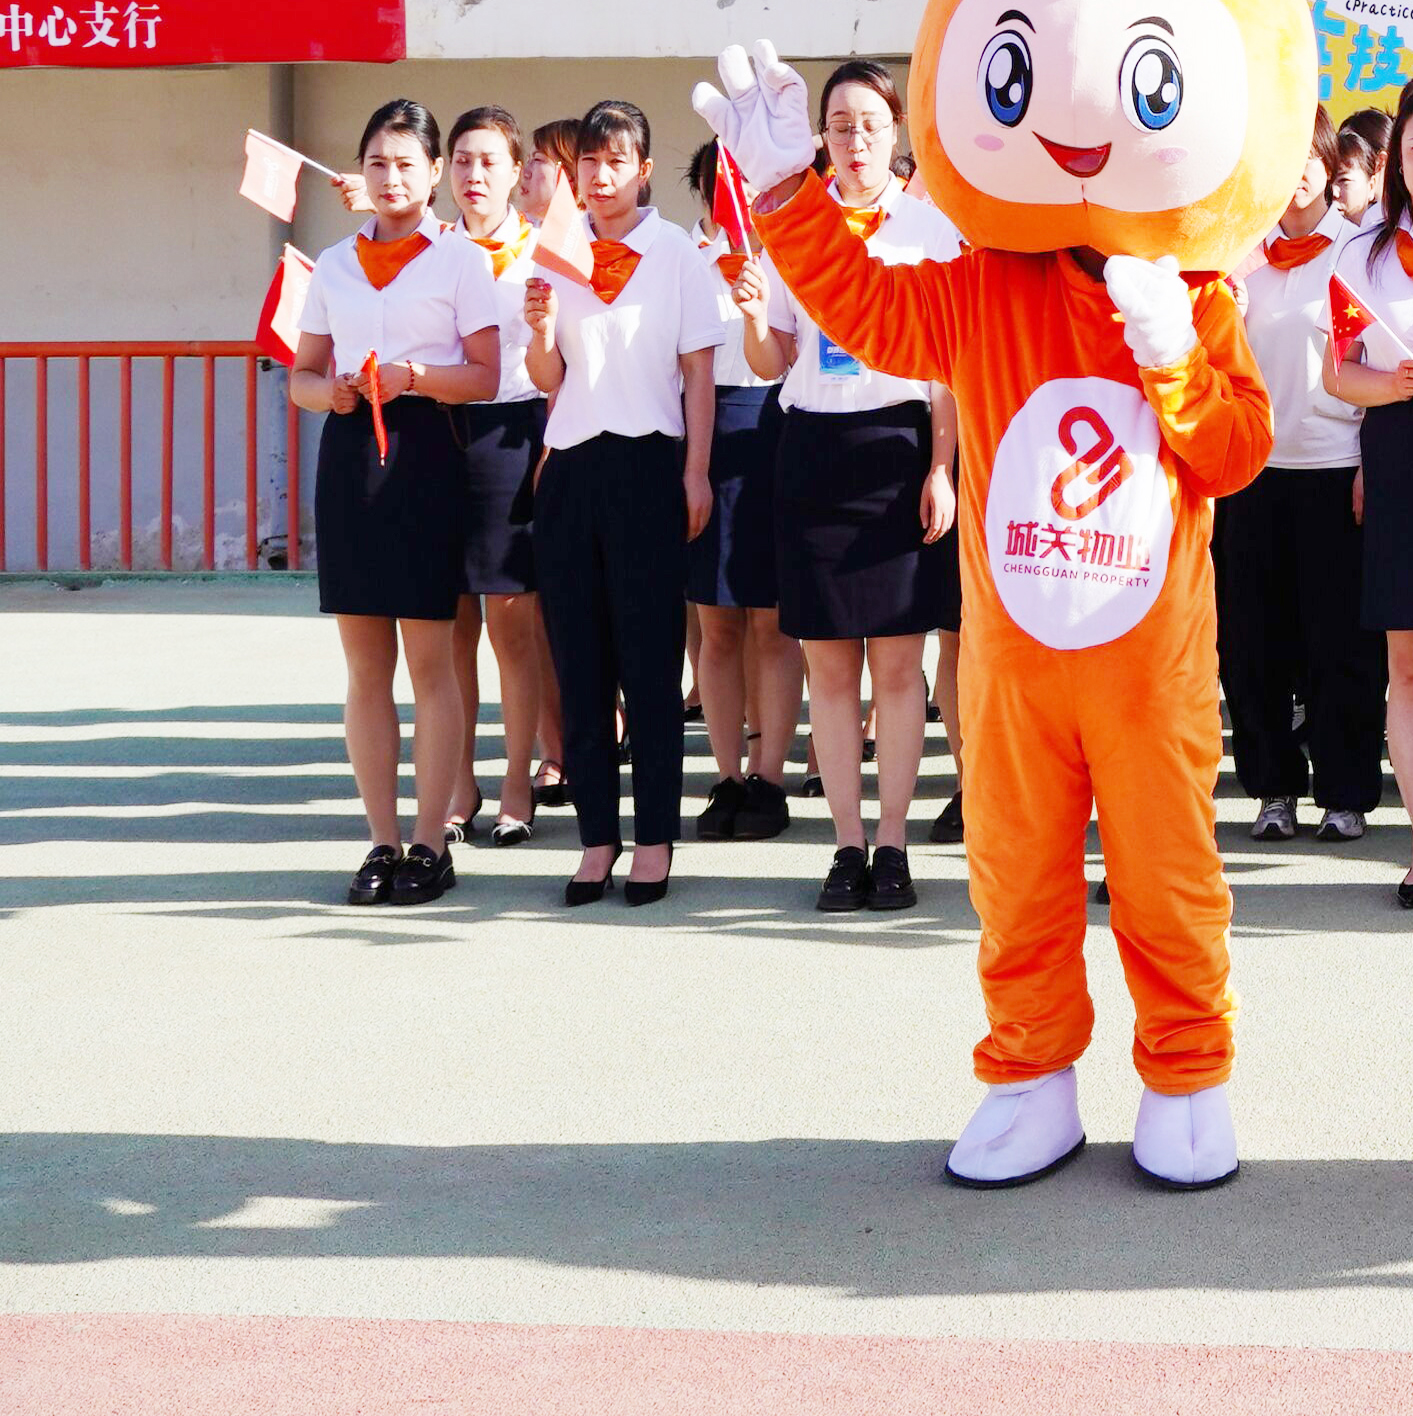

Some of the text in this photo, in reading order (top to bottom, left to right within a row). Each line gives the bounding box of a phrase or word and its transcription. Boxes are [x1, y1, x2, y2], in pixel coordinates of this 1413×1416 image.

[0, 0, 163, 52] 中心支行
[1004, 519, 1151, 572] 城关物业
[1003, 562, 1151, 588] CHENGGUAN PROPERTY
